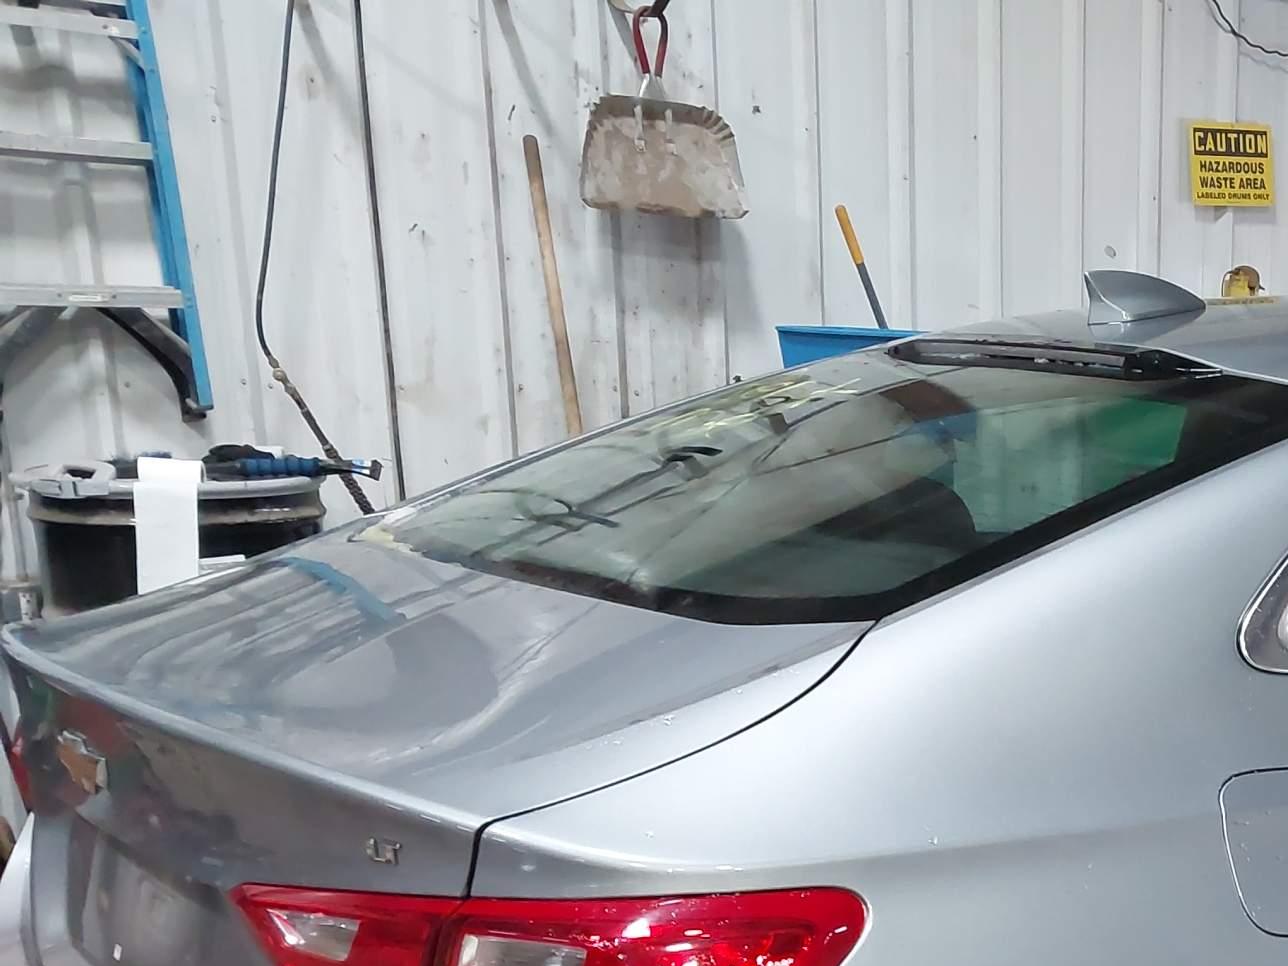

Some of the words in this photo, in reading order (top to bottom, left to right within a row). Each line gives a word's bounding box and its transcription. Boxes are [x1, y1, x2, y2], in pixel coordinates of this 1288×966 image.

[1194, 131, 1267, 154] CAUTION
[1199, 160, 1265, 174] HAZARDOUS
[1199, 176, 1236, 189] WASTE
[1238, 177, 1267, 190] AREA
[1196, 191, 1226, 200] LABELED
[1252, 193, 1270, 201] ONLY
[366, 837, 401, 866] LT
